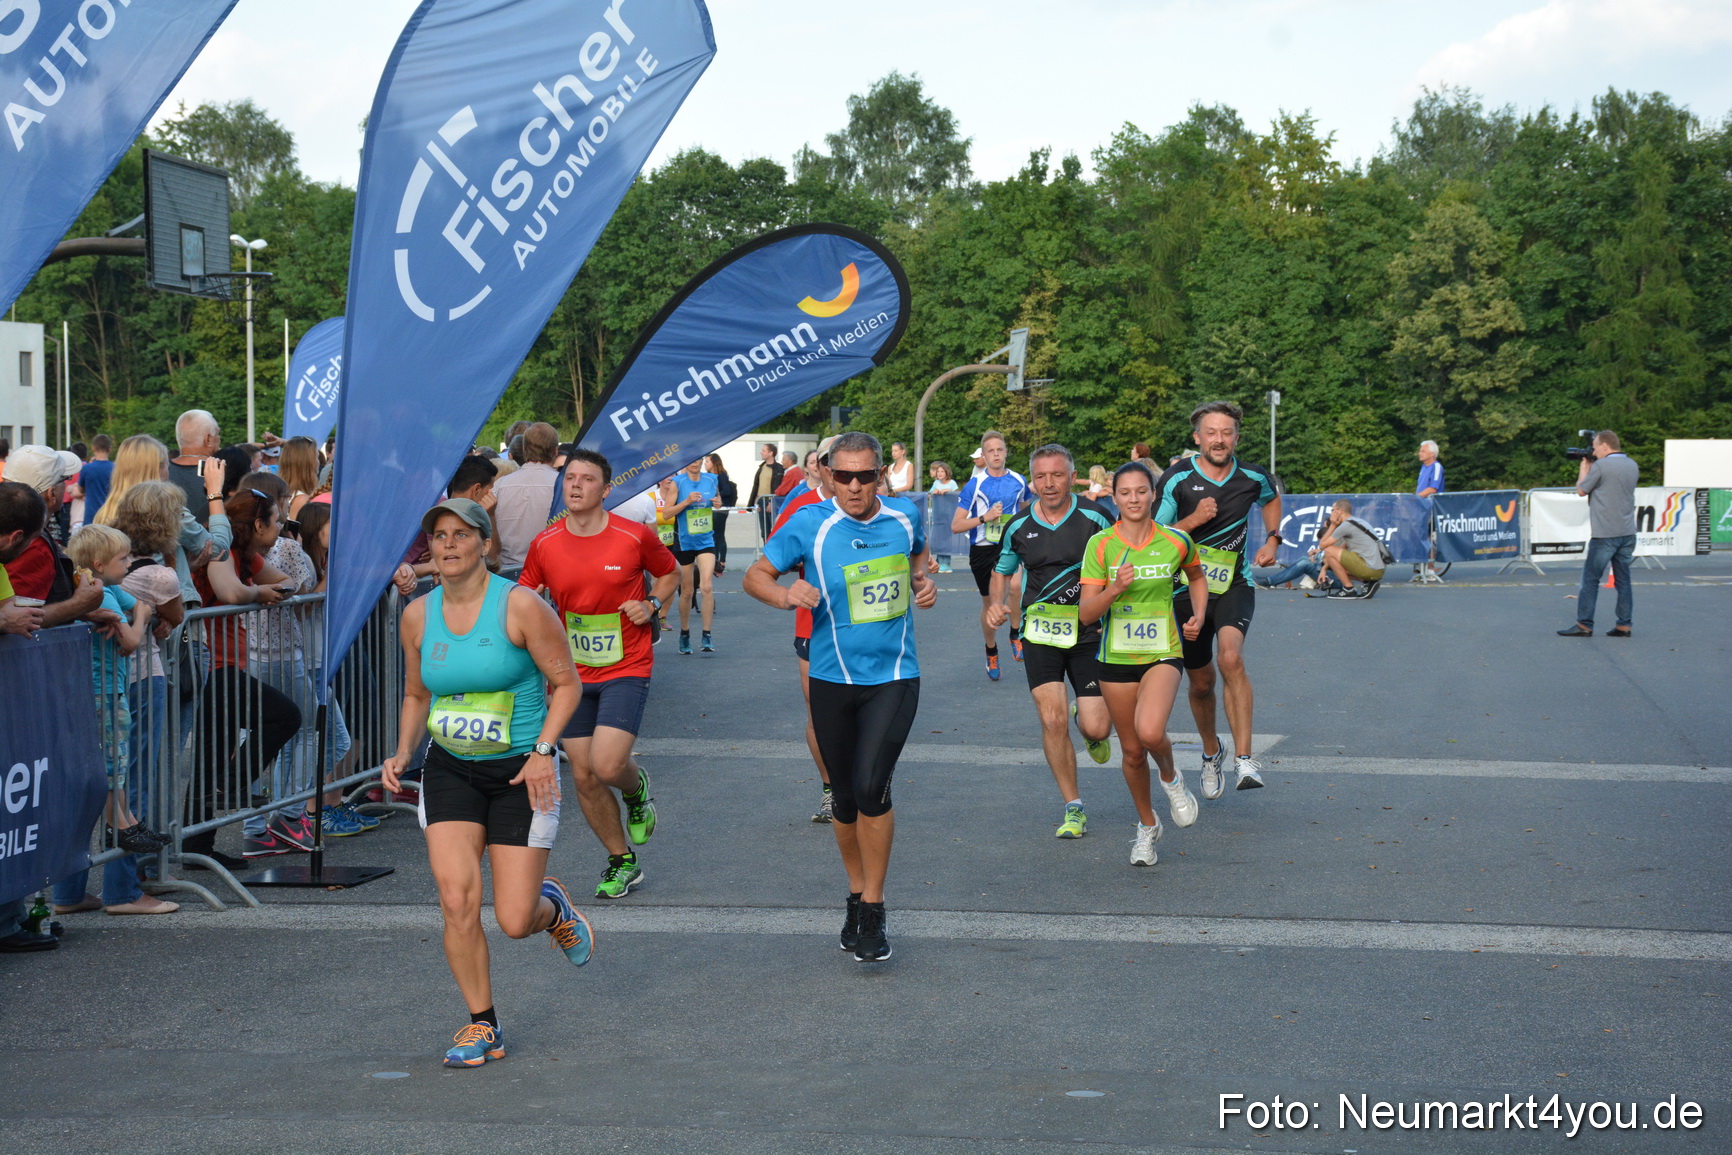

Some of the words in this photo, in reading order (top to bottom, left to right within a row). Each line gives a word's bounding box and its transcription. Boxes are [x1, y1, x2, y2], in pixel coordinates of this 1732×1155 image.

[3, 0, 131, 152] AUTO
[441, 0, 636, 274] Fischer
[512, 46, 659, 271] AUTOMOBILE
[745, 360, 795, 393] Druck
[797, 344, 830, 366] und
[829, 311, 889, 351] Medien
[609, 322, 819, 442] Frischmann
[693, 518, 709, 528] 454
[1437, 513, 1497, 533] Frischmann
[1487, 532, 1498, 541] und
[862, 580, 900, 605] 523
[1032, 618, 1073, 636] 1353
[1123, 622, 1158, 640] 146
[571, 633, 616, 652] 1057
[437, 715, 502, 742] 1295
